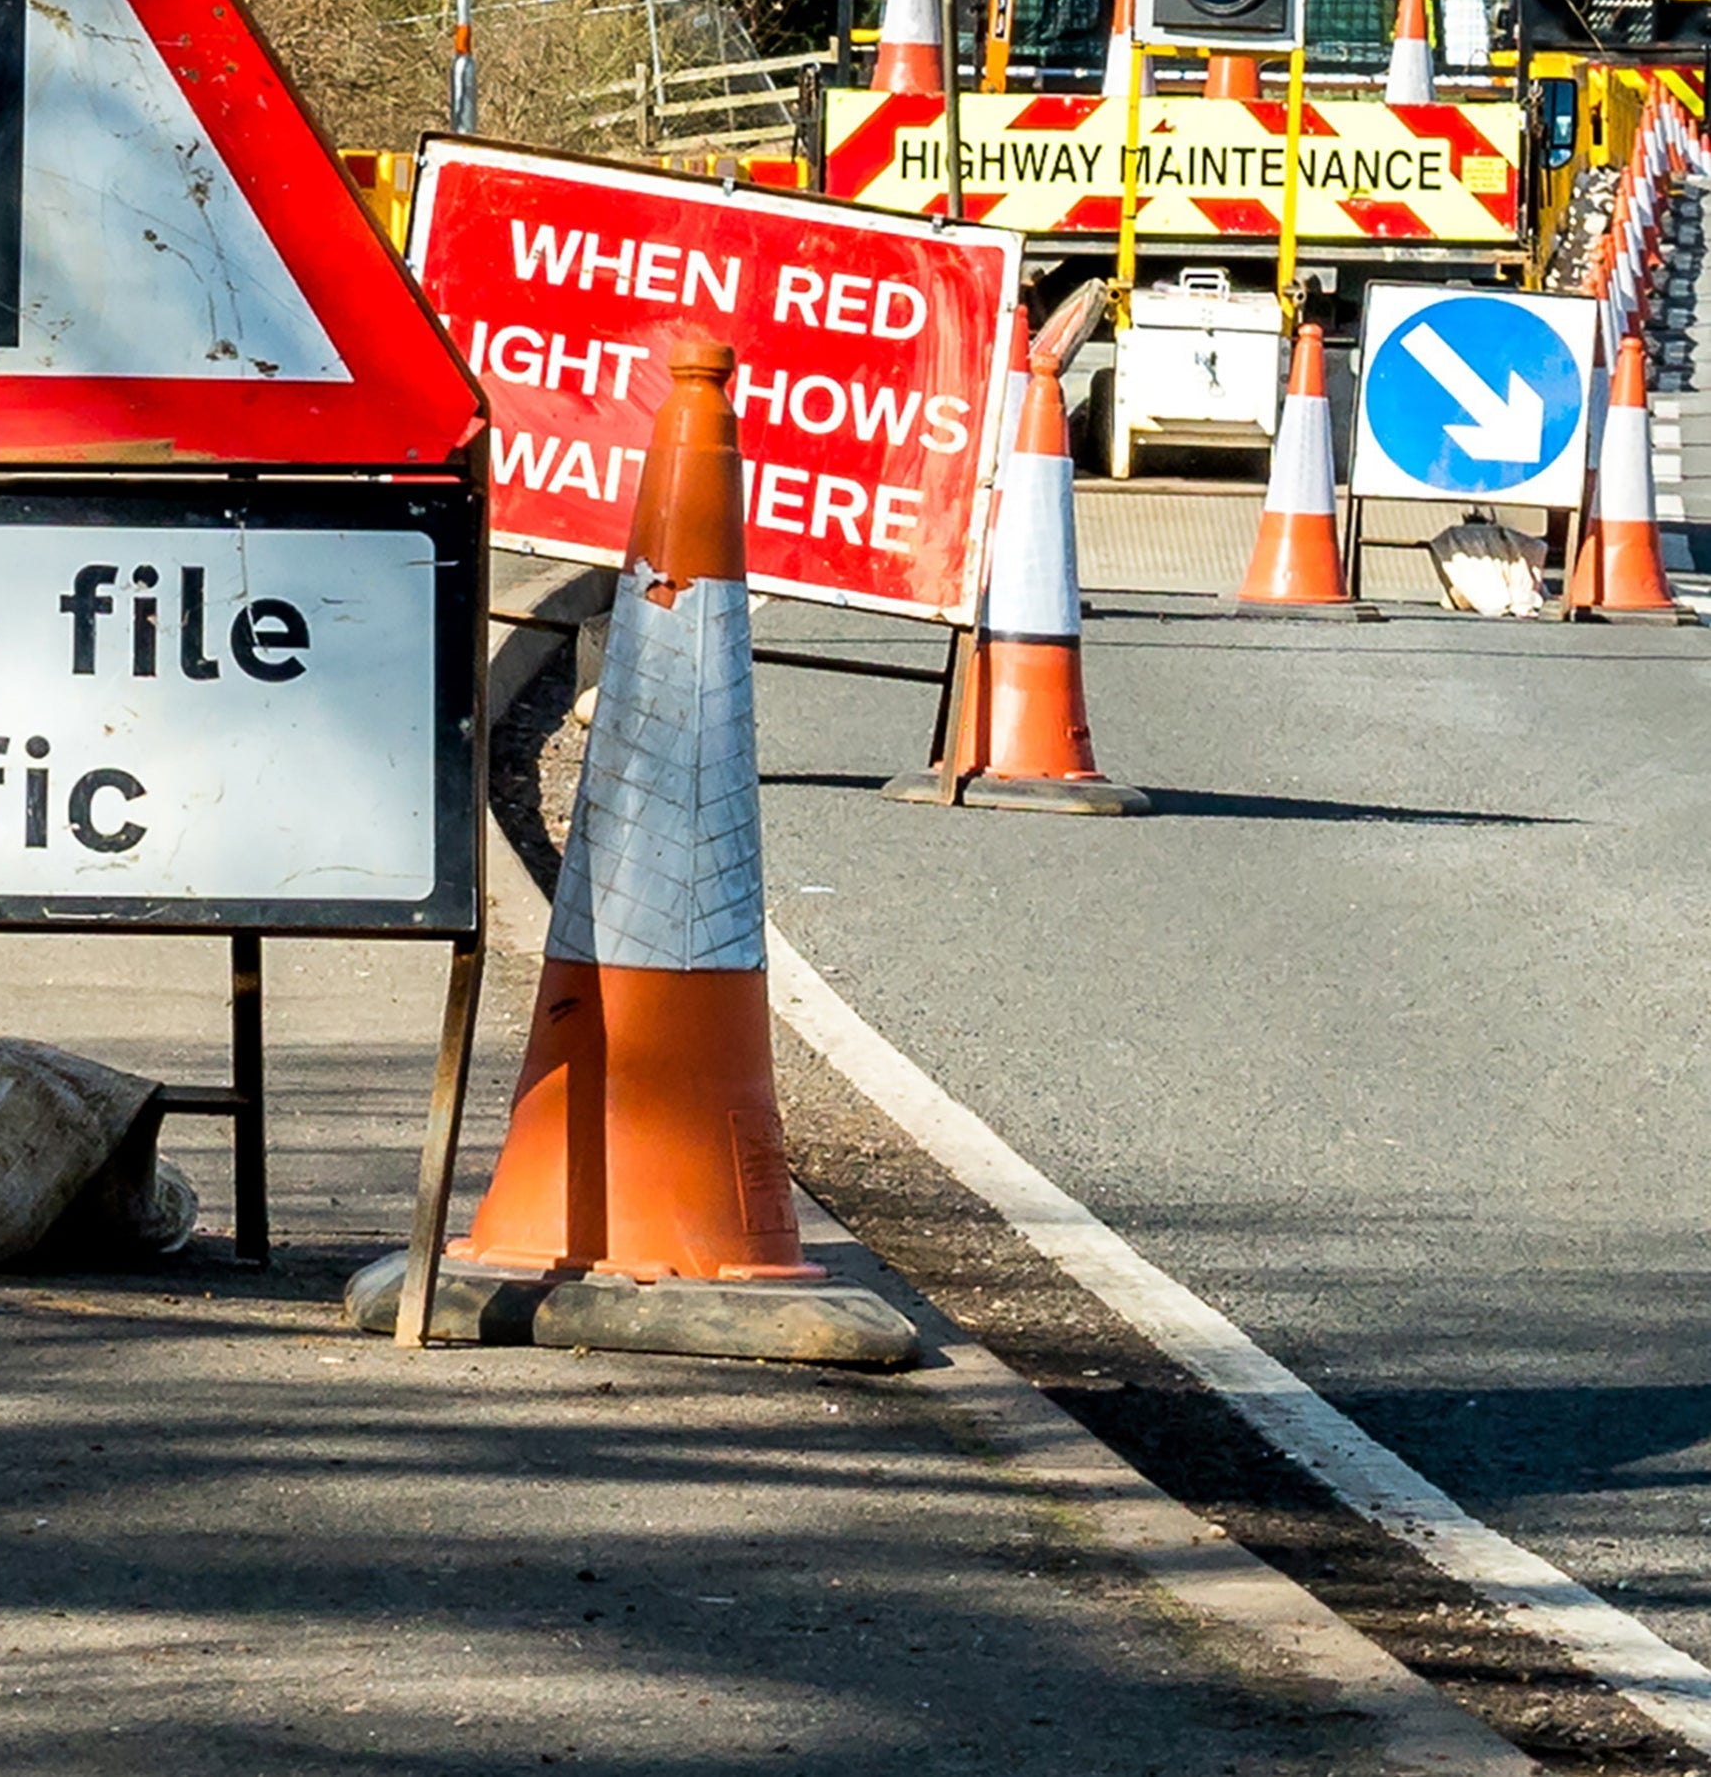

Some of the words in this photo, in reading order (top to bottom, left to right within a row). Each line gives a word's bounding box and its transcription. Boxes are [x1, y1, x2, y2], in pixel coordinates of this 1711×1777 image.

[1120, 144, 1442, 191] MAINTENANCE
[511, 219, 741, 314] WHEN
[773, 265, 928, 341] RED
[439, 313, 649, 401] IGHT
[733, 363, 970, 454] HOWS
[59, 564, 311, 683] file
